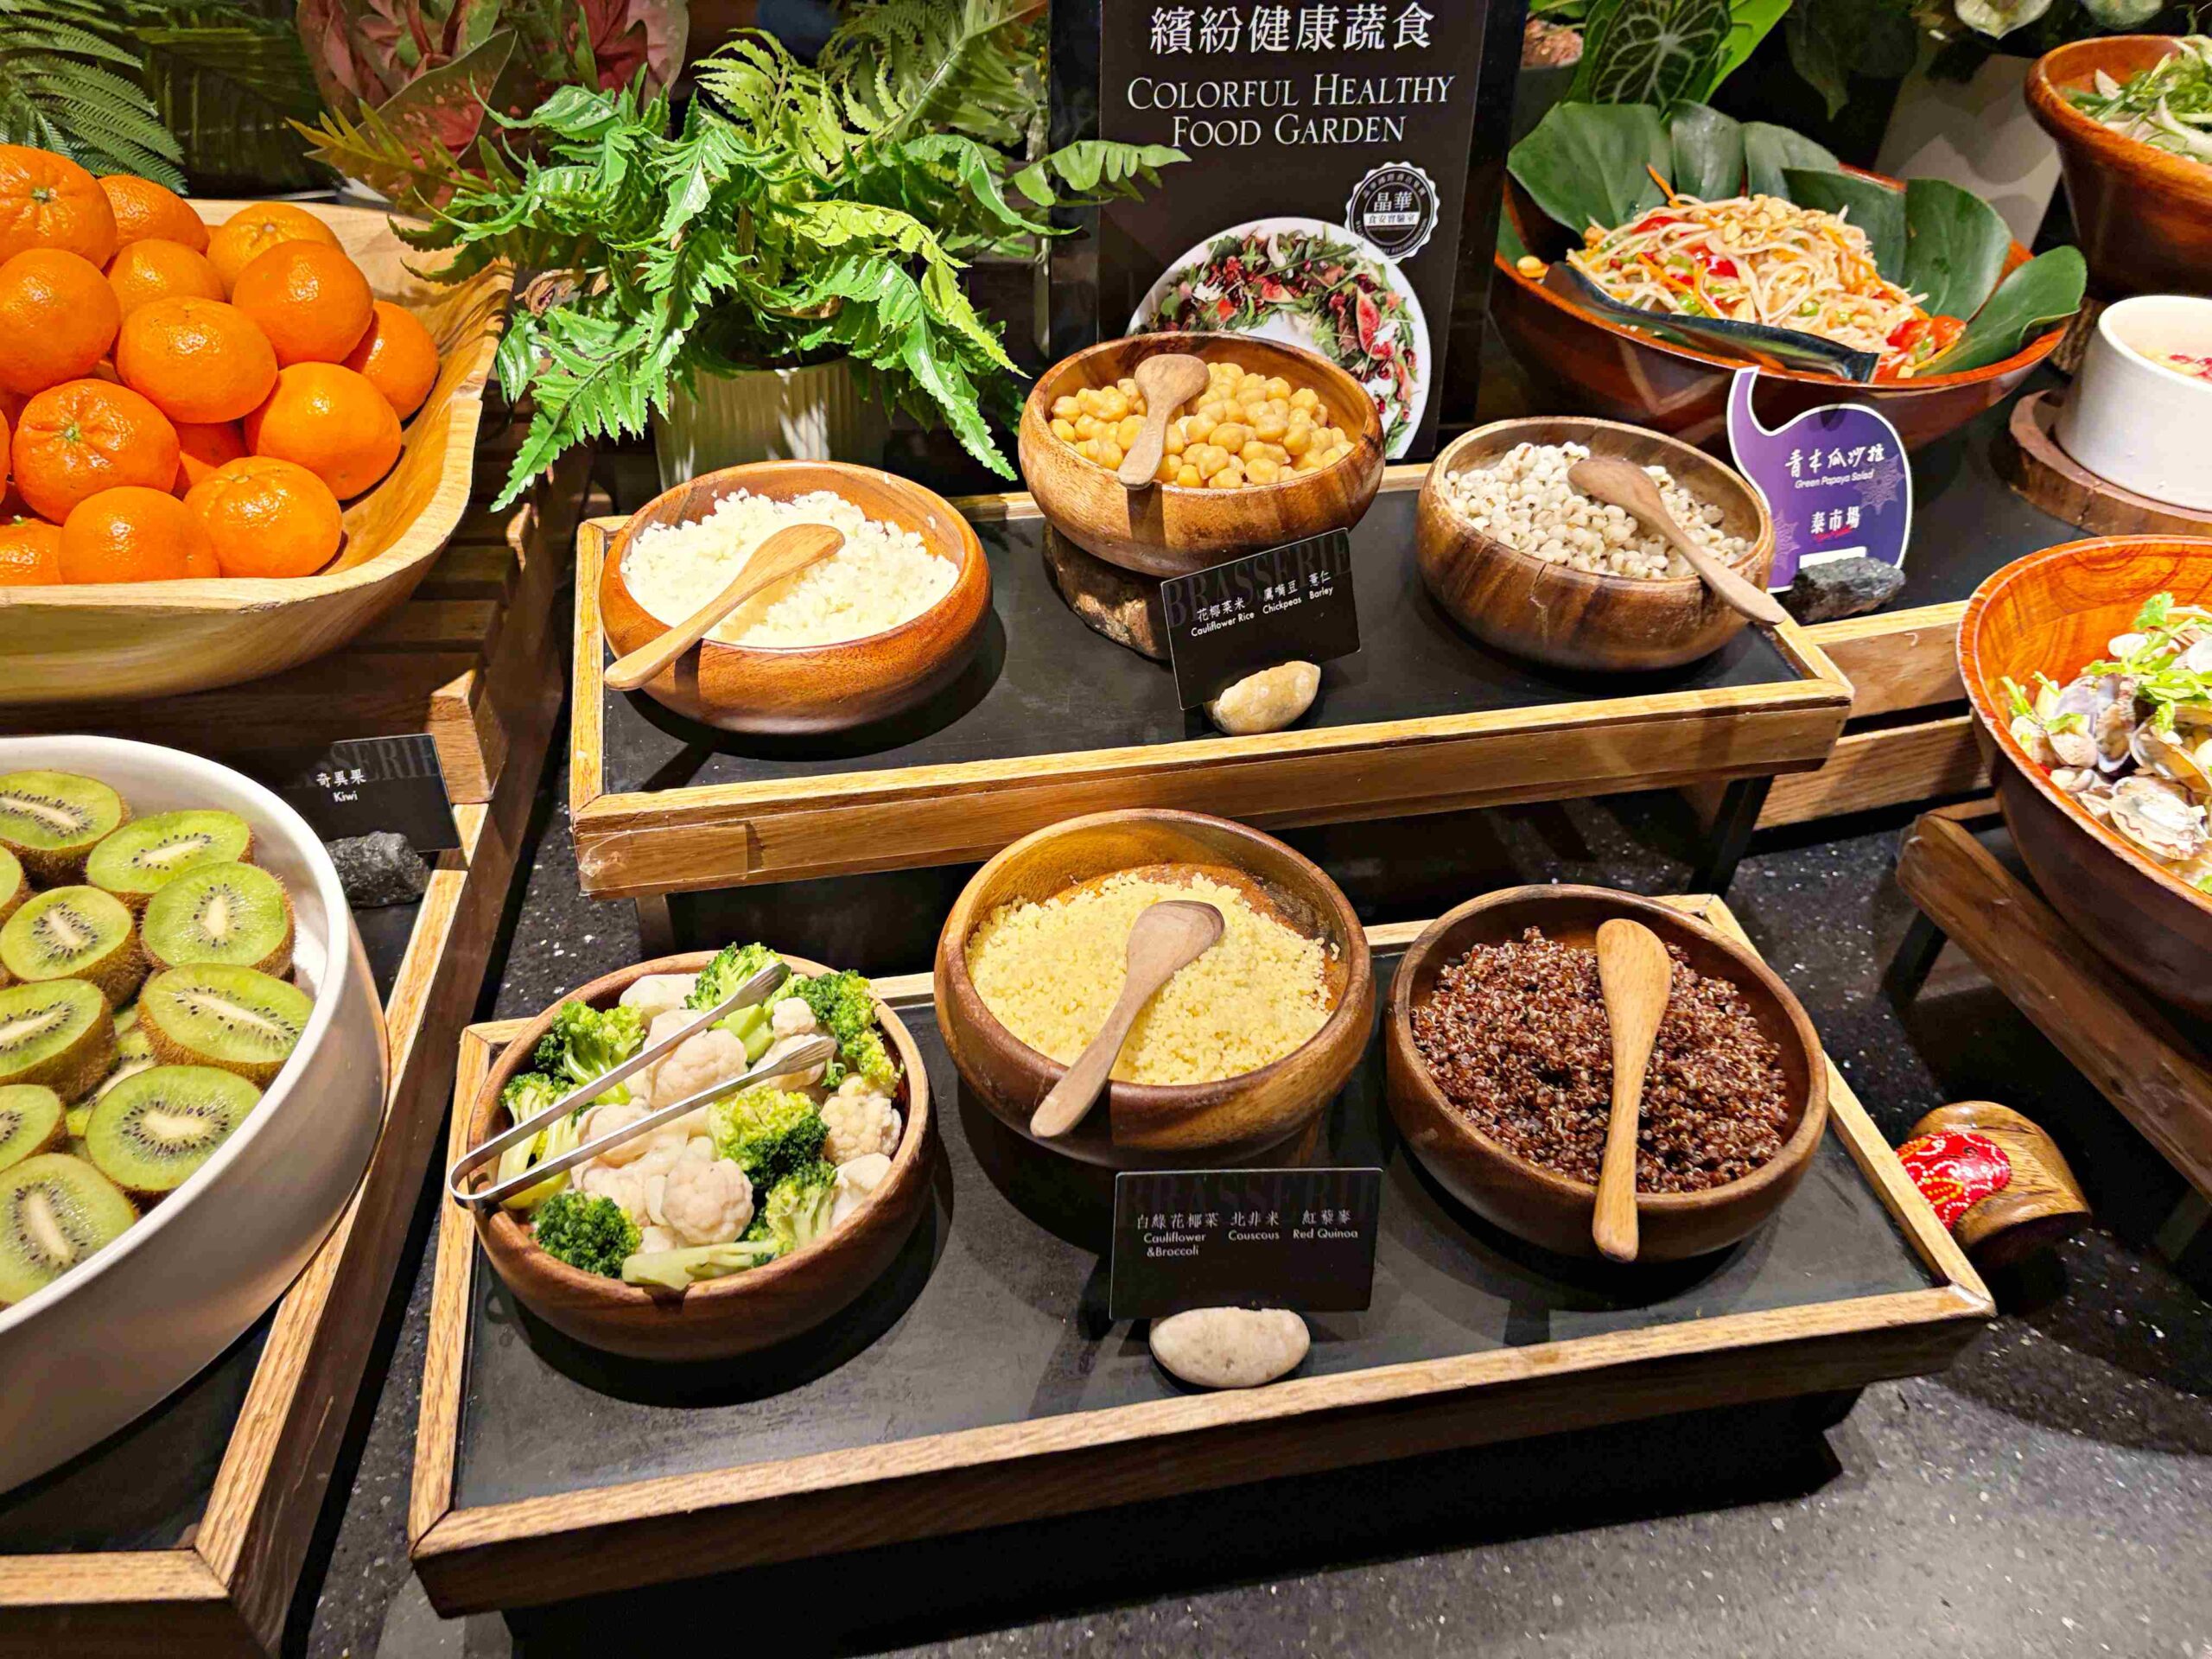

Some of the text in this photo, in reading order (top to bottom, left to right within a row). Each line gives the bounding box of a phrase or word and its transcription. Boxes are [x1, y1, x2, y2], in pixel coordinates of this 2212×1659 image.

[1150, 2, 1434, 54] 繽紛健康蔬食
[1128, 73, 1456, 110] COLORFUL HEALTHY
[1173, 114, 1407, 148] FOOD GARDEN
[1373, 191, 1413, 212] 晶華
[1784, 443, 1885, 478] 青木瓜沙拉
[1795, 468, 1875, 489] Green Papaya Salad
[1810, 506, 1860, 534] 泰市場
[1164, 532, 1351, 628] BRASSERIE
[1197, 570, 1332, 622] 花椰菜米 鷹嘴豆 薏仁
[1191, 587, 1333, 637] Cauliflower Rice Chickpeas Barley
[316, 768, 366, 788] 奇異果
[333, 791, 358, 803] Kiwi
[1230, 1211, 1279, 1227] 北非米
[1143, 1228, 1358, 1243] Cauliflower Couscous Red Quinoa
[1147, 1244, 1199, 1257] &Broccoli
